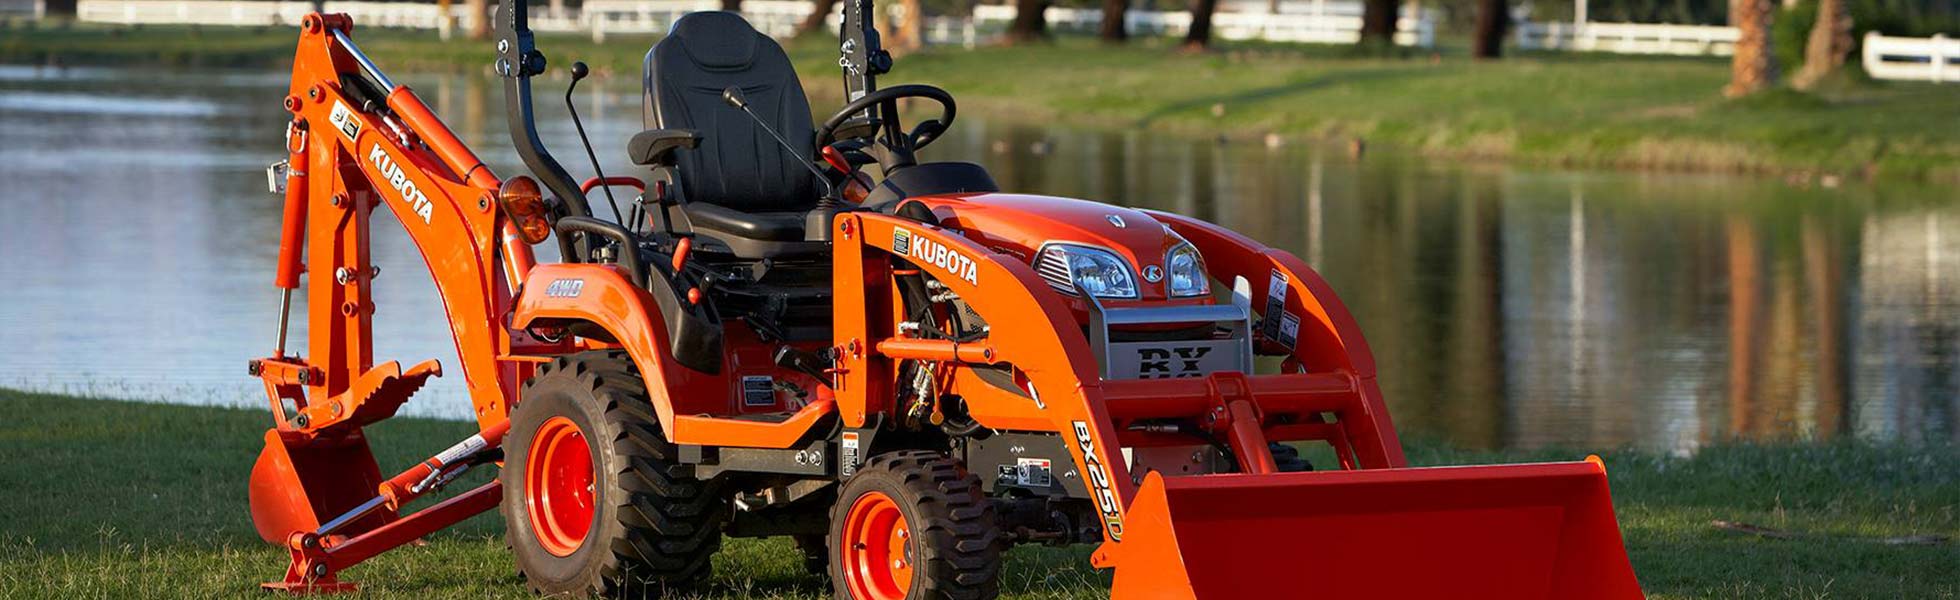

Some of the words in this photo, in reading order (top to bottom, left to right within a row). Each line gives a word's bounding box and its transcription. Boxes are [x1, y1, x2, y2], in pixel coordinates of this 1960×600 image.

[368, 142, 434, 225] KUBOTA
[912, 234, 977, 286] KUBOTA
[545, 278, 584, 298] 4WD
[1137, 346, 1212, 379] BX
[1072, 420, 1123, 542] BX25D
